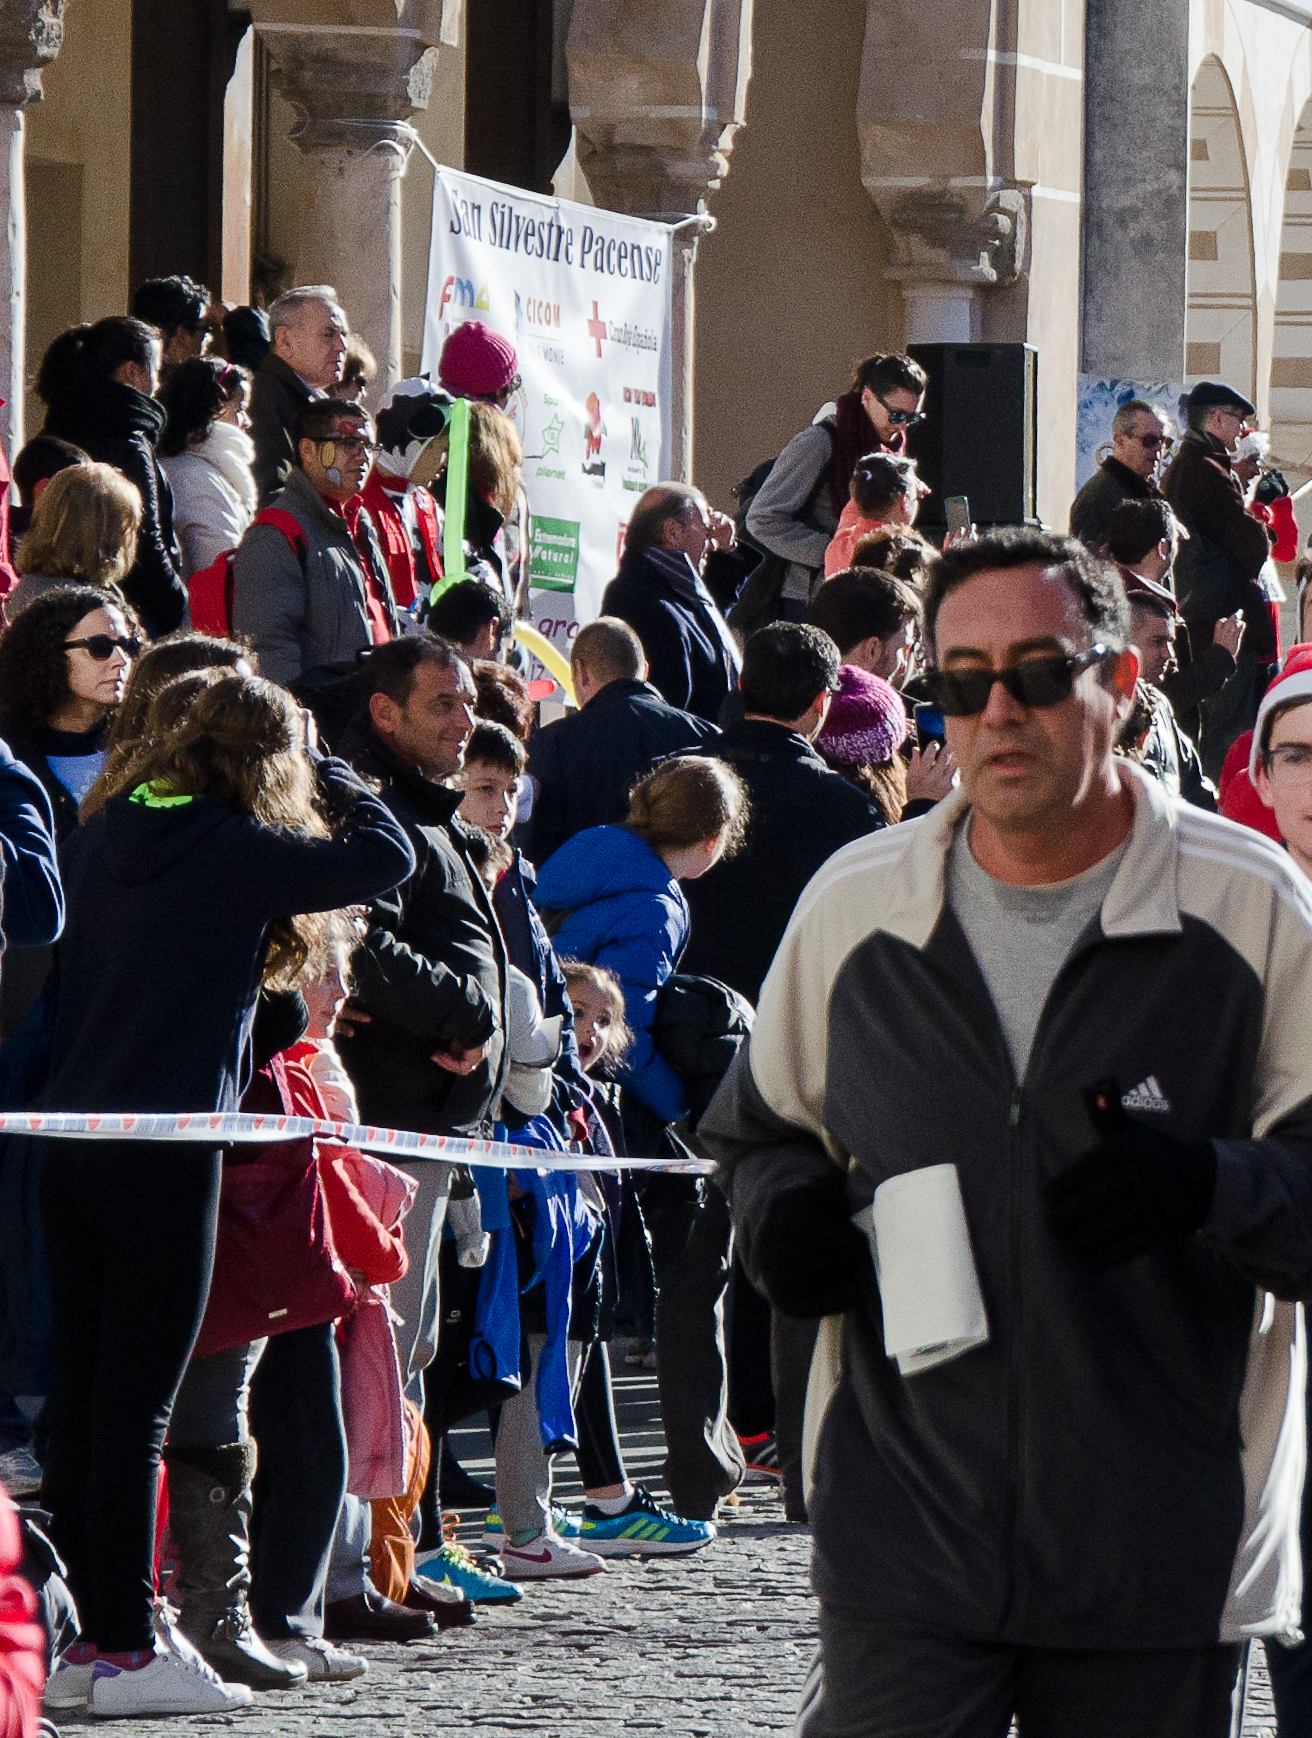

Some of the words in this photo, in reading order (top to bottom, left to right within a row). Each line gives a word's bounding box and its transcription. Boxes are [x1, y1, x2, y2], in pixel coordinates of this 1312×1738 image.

[450, 188, 482, 242] San
[489, 200, 574, 266] Silvestre
[579, 224, 662, 285] Pacense
[526, 296, 561, 329] CICOM
[1121, 1095, 1171, 1113] adidas
